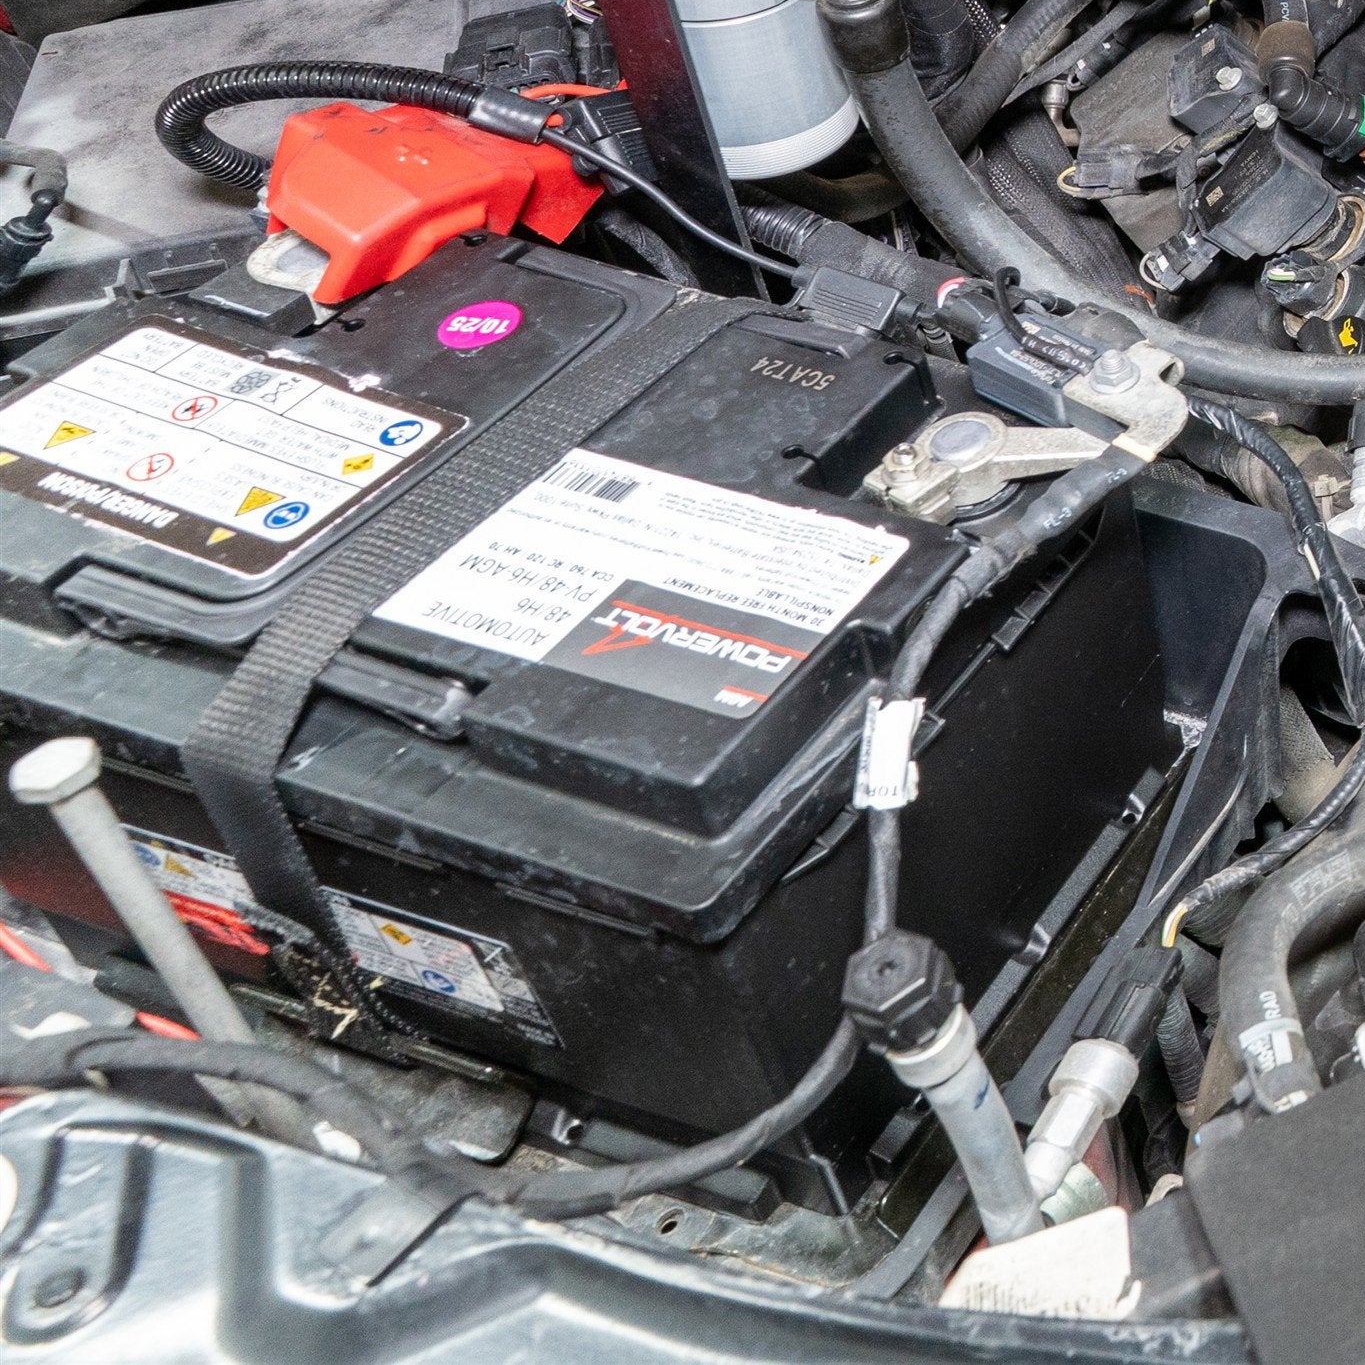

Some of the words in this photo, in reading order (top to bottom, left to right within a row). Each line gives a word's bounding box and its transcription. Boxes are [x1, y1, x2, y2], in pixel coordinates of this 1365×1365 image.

[447, 313, 512, 336] 10/25
[748, 354, 837, 393] 5CAT24
[318, 395, 394, 425] INSTRUCTIONS
[32, 468, 185, 529] DANGER/POISON
[486, 541, 505, 551] 70
[501, 545, 522, 556] AH
[524, 551, 549, 563] 120
[544, 557, 565, 568] RC
[566, 563, 592, 575] 760
[455, 552, 600, 602] PV-48/H6-AGM
[587, 569, 615, 582] CCA
[660, 575, 742, 603] REPLACEMENT
[753, 587, 837, 616] NONSPILLABLE
[509, 596, 576, 624] 48/H6
[738, 596, 768, 610] FREE
[763, 602, 810, 622] MONTH
[419, 600, 552, 647] AUTOMOTIVE
[588, 604, 794, 674] POWERVOLT
[711, 688, 754, 709] AGM
[1254, 987, 1287, 1022] RAD
